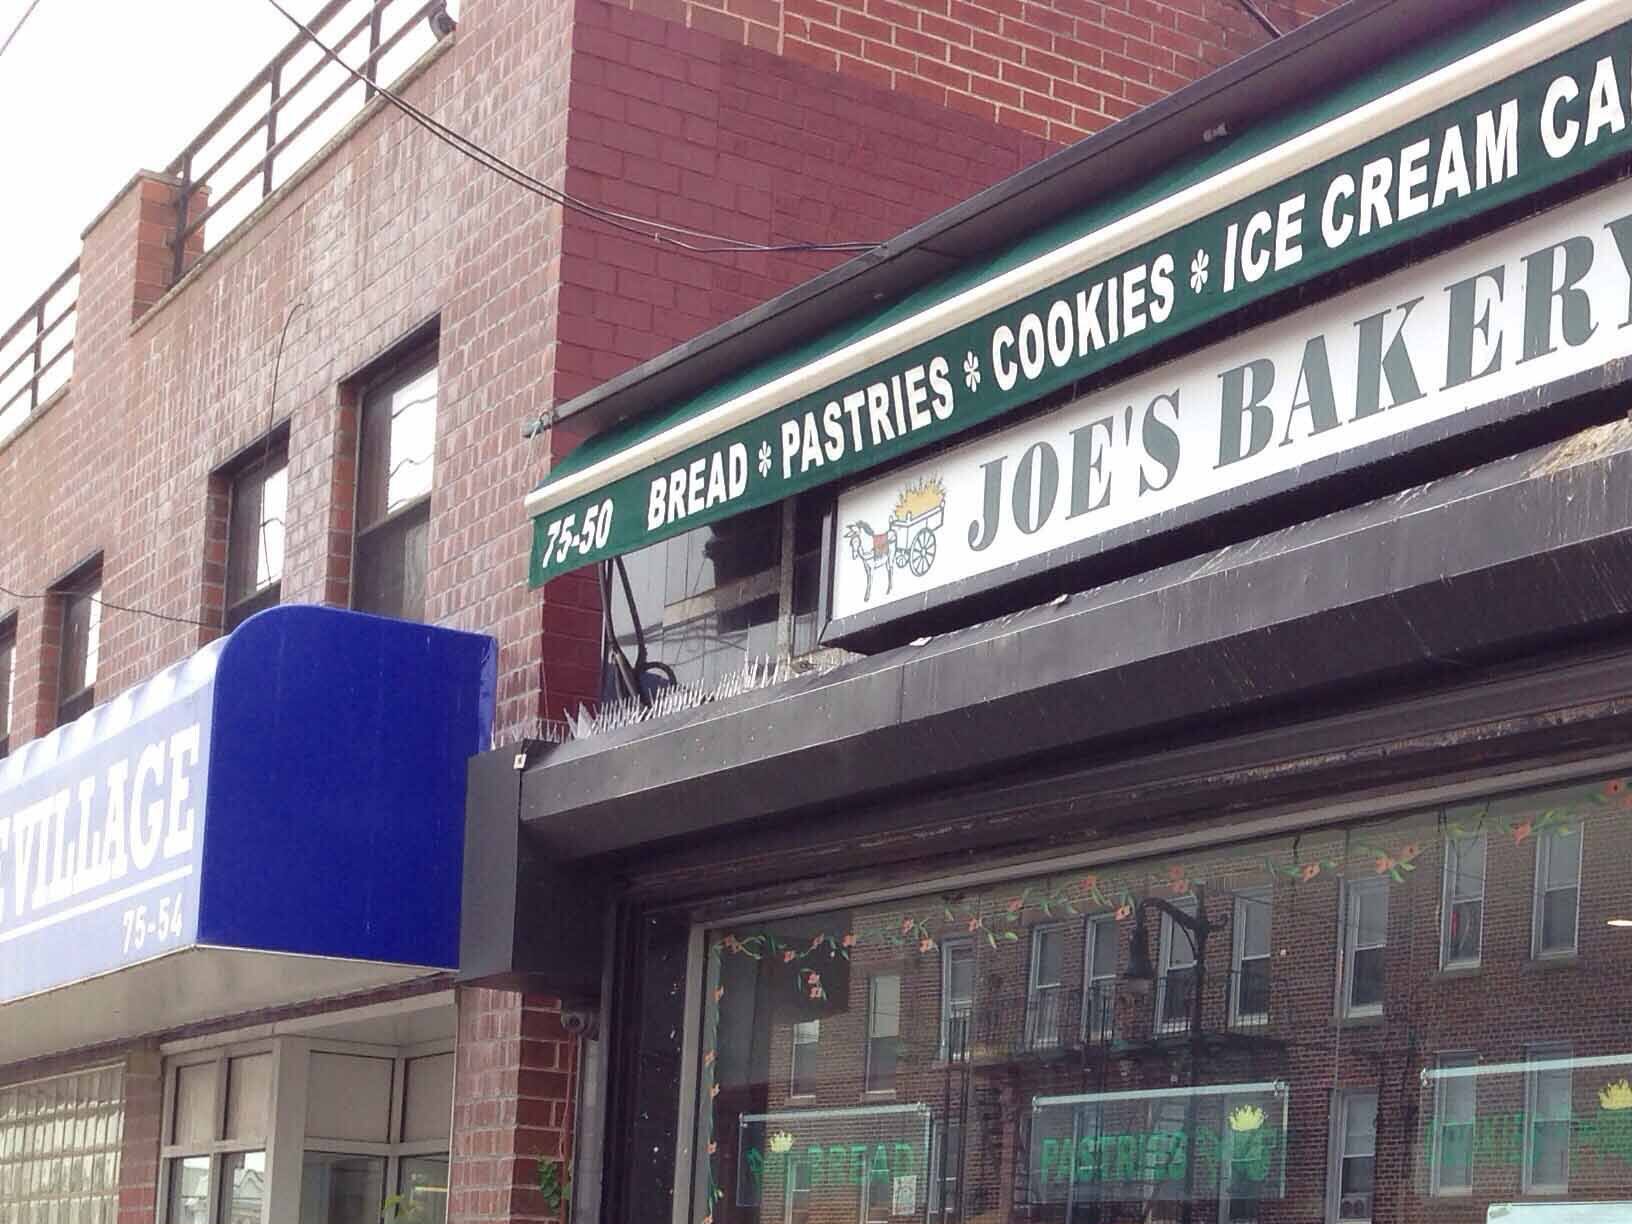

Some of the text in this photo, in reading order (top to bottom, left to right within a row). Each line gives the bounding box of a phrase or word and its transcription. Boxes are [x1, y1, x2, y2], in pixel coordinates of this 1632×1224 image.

[542, 499, 613, 567] 75-50
[646, 443, 749, 530] BREAD
[782, 356, 954, 478] PASTRIES
[992, 254, 1175, 391] COOKIES
[1223, 192, 1304, 292] ICE
[1321, 99, 1518, 248] CREAM
[968, 389, 1181, 553] JOE'S
[12, 724, 201, 918] VILLAGE
[122, 893, 182, 953] 75-54
